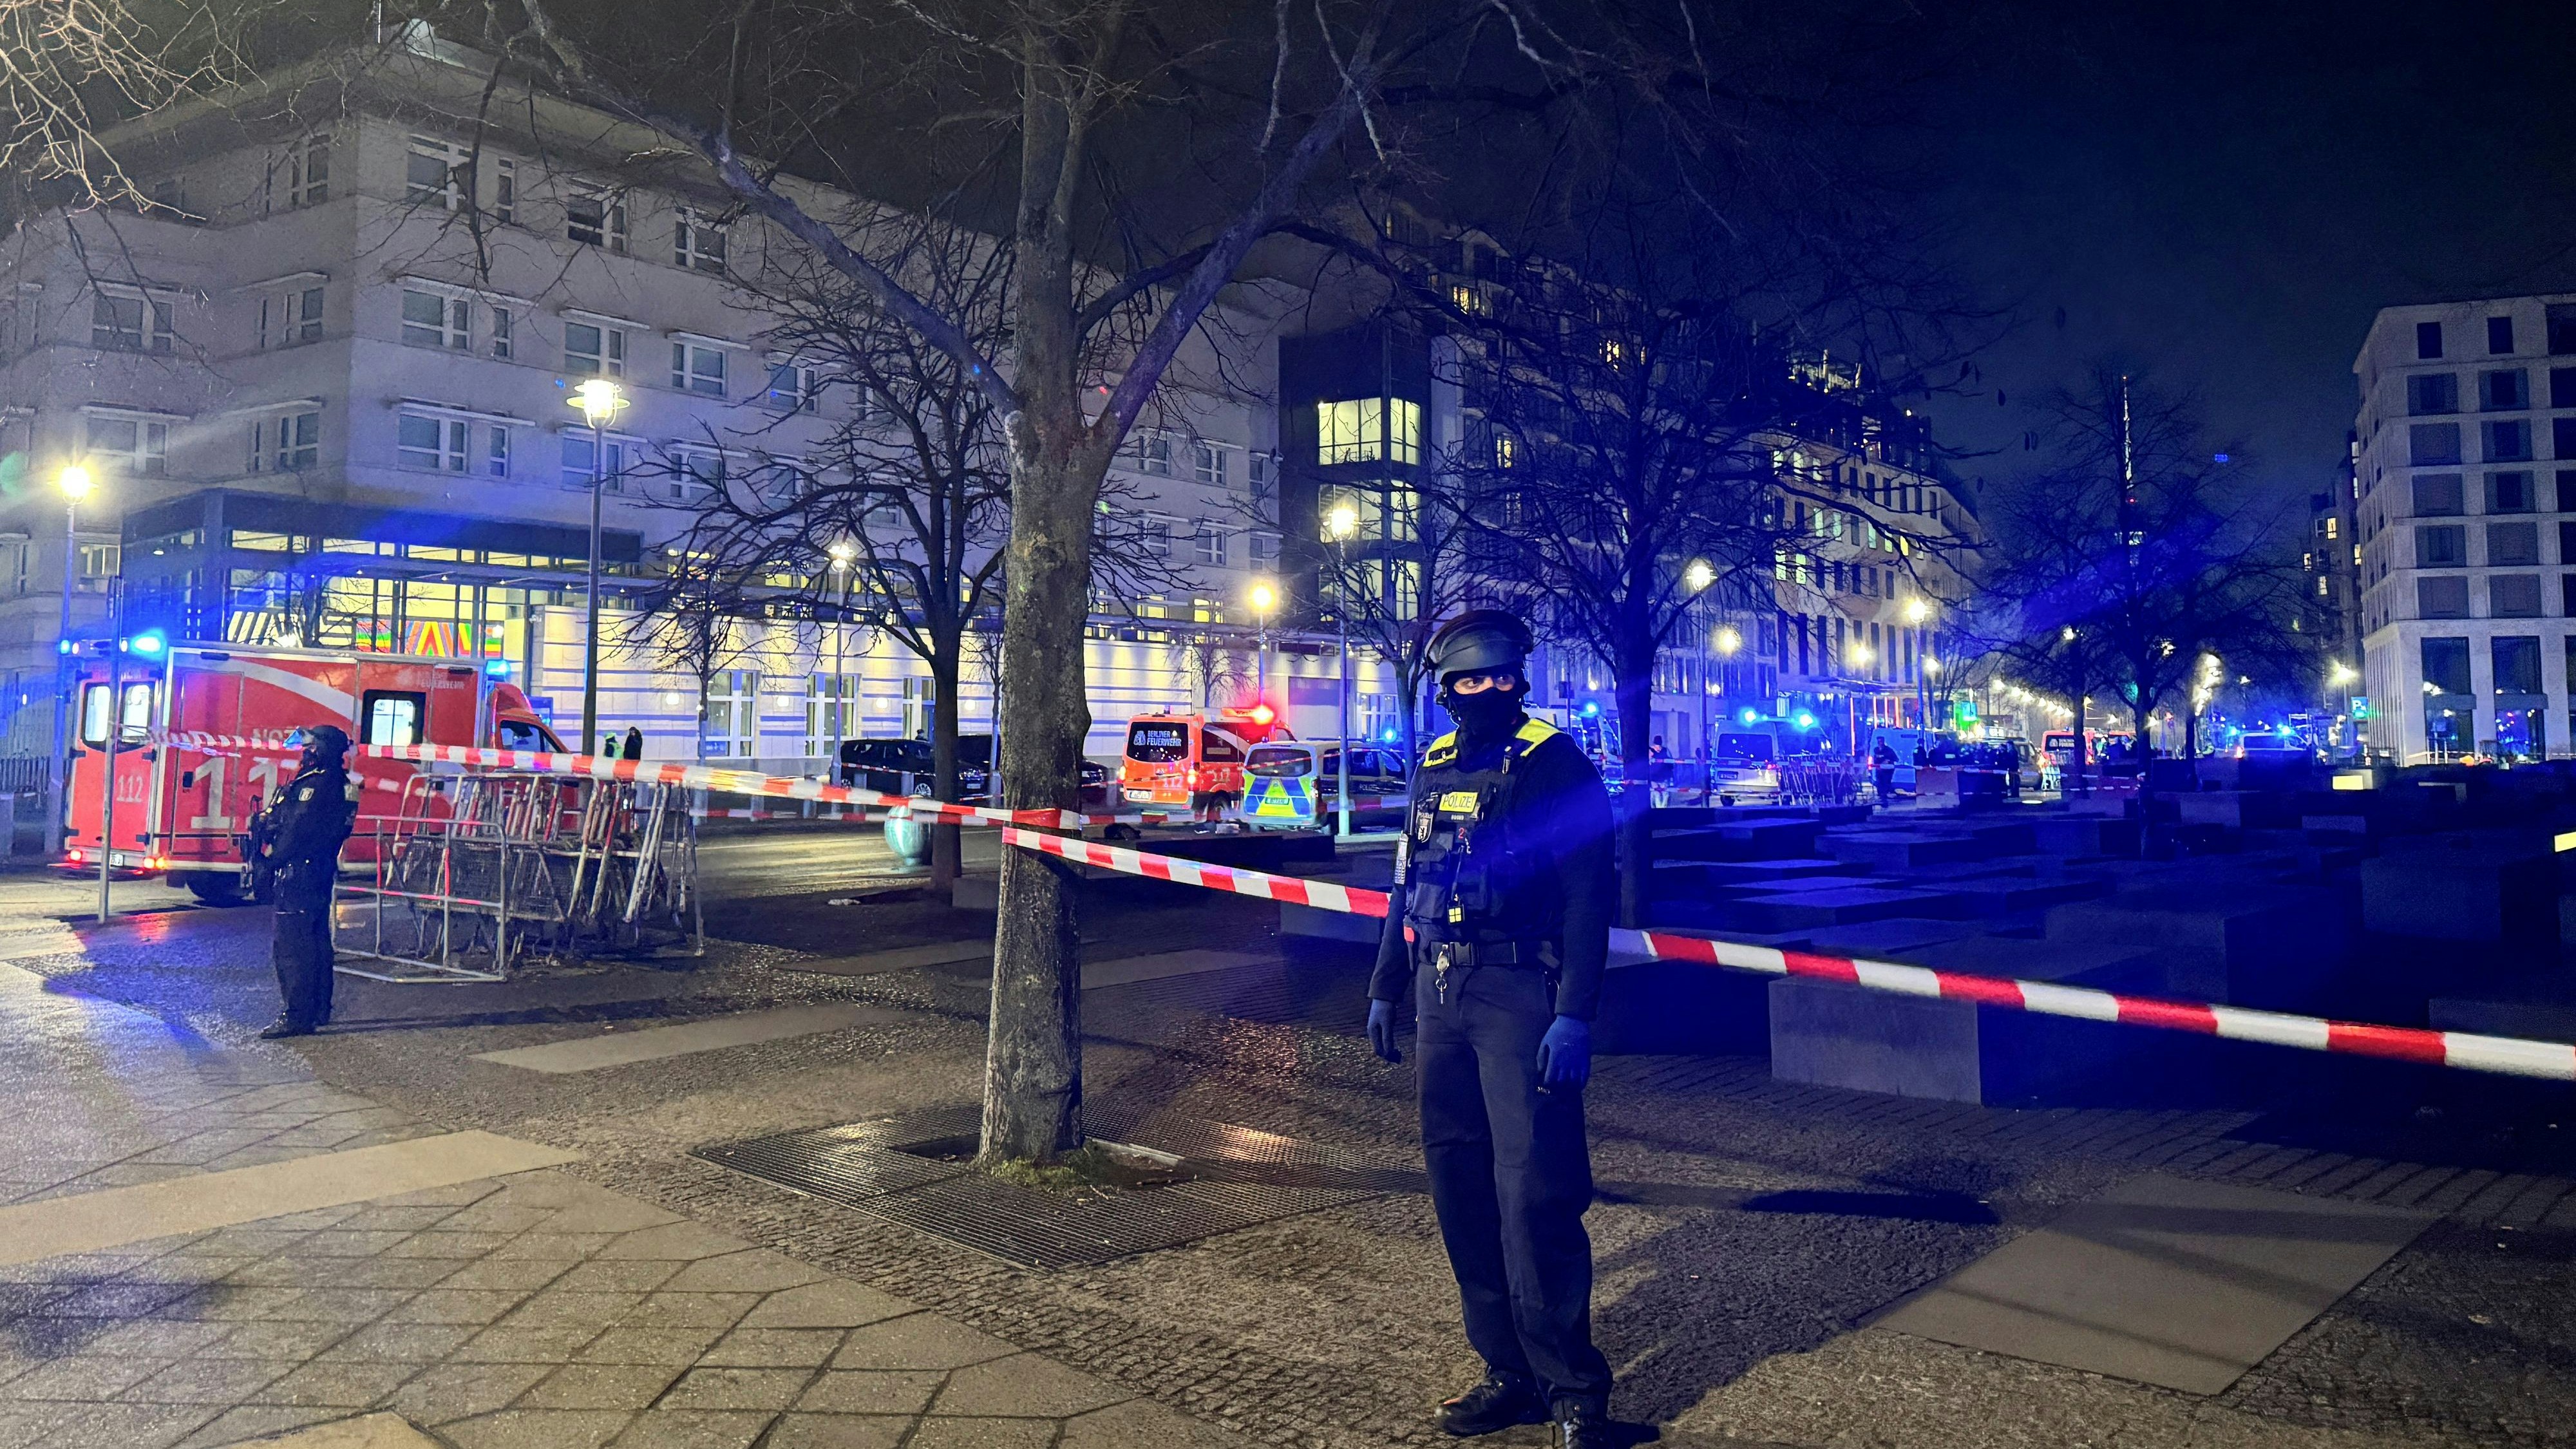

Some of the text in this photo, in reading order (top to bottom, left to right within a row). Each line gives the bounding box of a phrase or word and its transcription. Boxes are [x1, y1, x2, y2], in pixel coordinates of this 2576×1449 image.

[1146, 737, 1182, 746] FEUERWEHR
[116, 774, 144, 802] 112
[1164, 776, 1182, 788] 112
[1443, 794, 1475, 808] POLIZEI
[1457, 827, 1465, 839] 2
